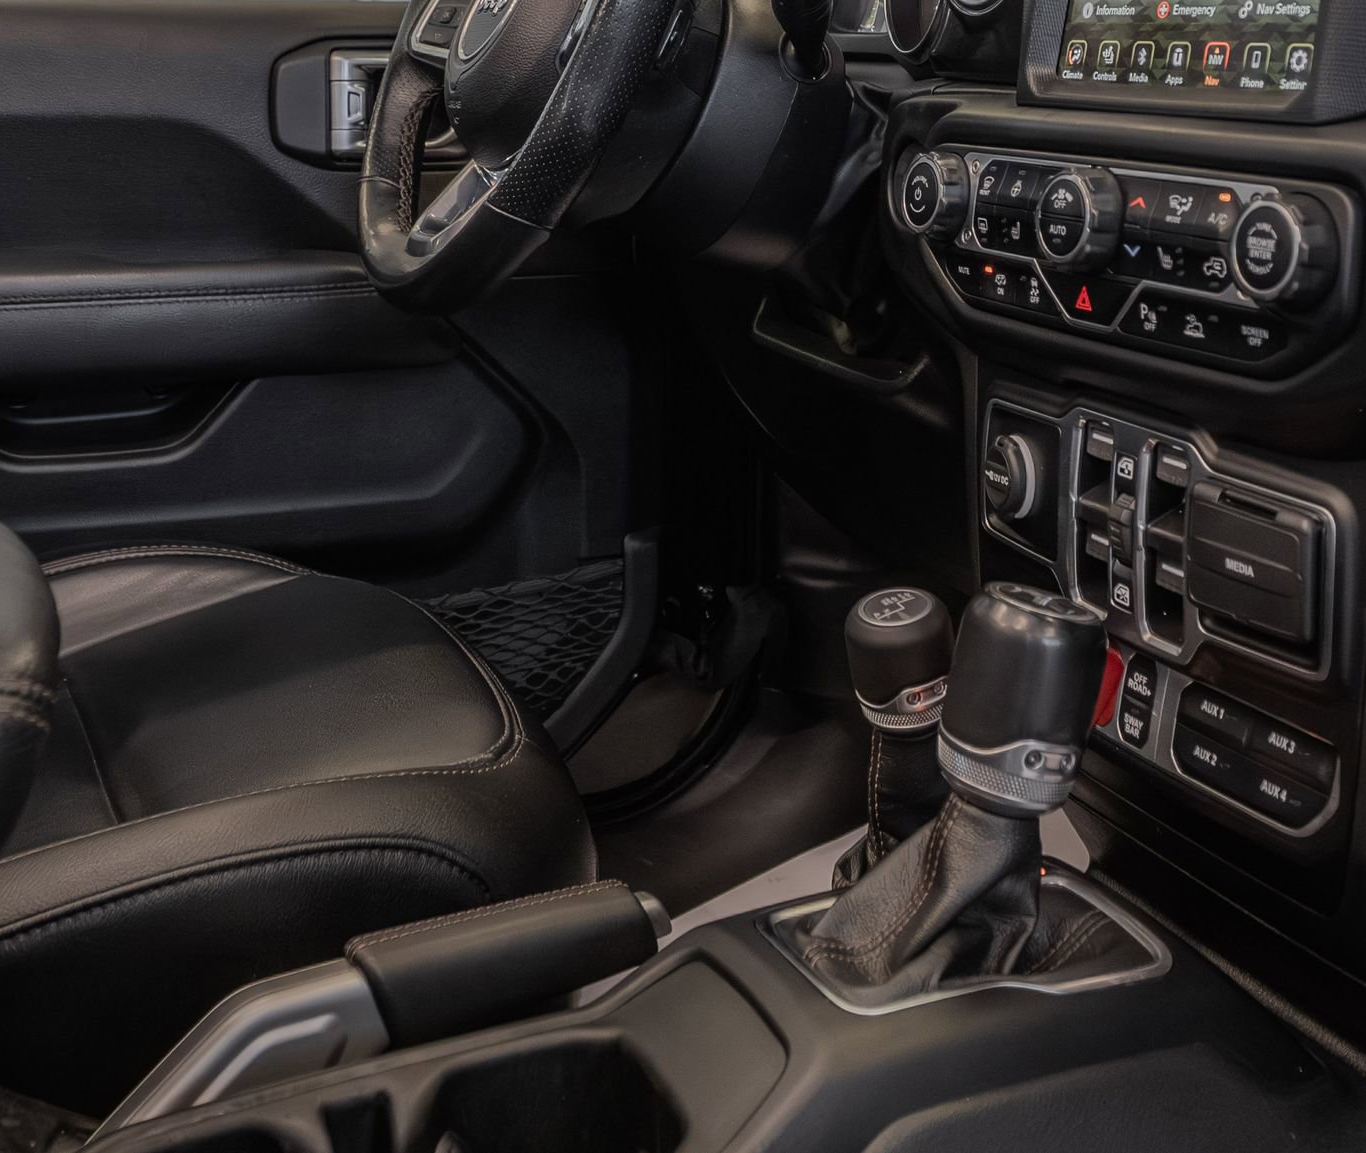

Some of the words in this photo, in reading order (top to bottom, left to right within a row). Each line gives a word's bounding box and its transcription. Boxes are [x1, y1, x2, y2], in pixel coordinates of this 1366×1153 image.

[1095, 4, 1136, 16] Information
[1172, 3, 1216, 18] Emergency
[1256, 2, 1275, 15] Nav
[1275, 2, 1311, 17] Settings
[1062, 69, 1084, 80] Climate
[1093, 71, 1117, 82] Controls
[1128, 72, 1149, 83] Media
[1164, 73, 1184, 86] Apps
[1204, 75, 1220, 87] Nav
[1240, 76, 1265, 89] Phone
[1054, 199, 1067, 209] OFF
[1207, 212, 1228, 225] A/C
[1049, 224, 1067, 236] AUTO
[1249, 248, 1272, 260] ENTER
[958, 266, 970, 275] MUTE
[1144, 322, 1156, 332] OFF
[1241, 325, 1269, 339] SCREEN
[1248, 337, 1263, 347] OFF
[1225, 557, 1255, 578] MEDIA
[1134, 672, 1148, 685] OFF
[1200, 699, 1220, 718] AUX
[1124, 712, 1144, 730] SWAY
[1125, 724, 1140, 740] BAR
[1267, 731, 1289, 752] AUX
[1288, 740, 1296, 755] 3
[1193, 744, 1212, 763] AUX
[1210, 753, 1218, 767] 2
[1259, 778, 1281, 800] AUX
[1280, 789, 1288, 803] 4
